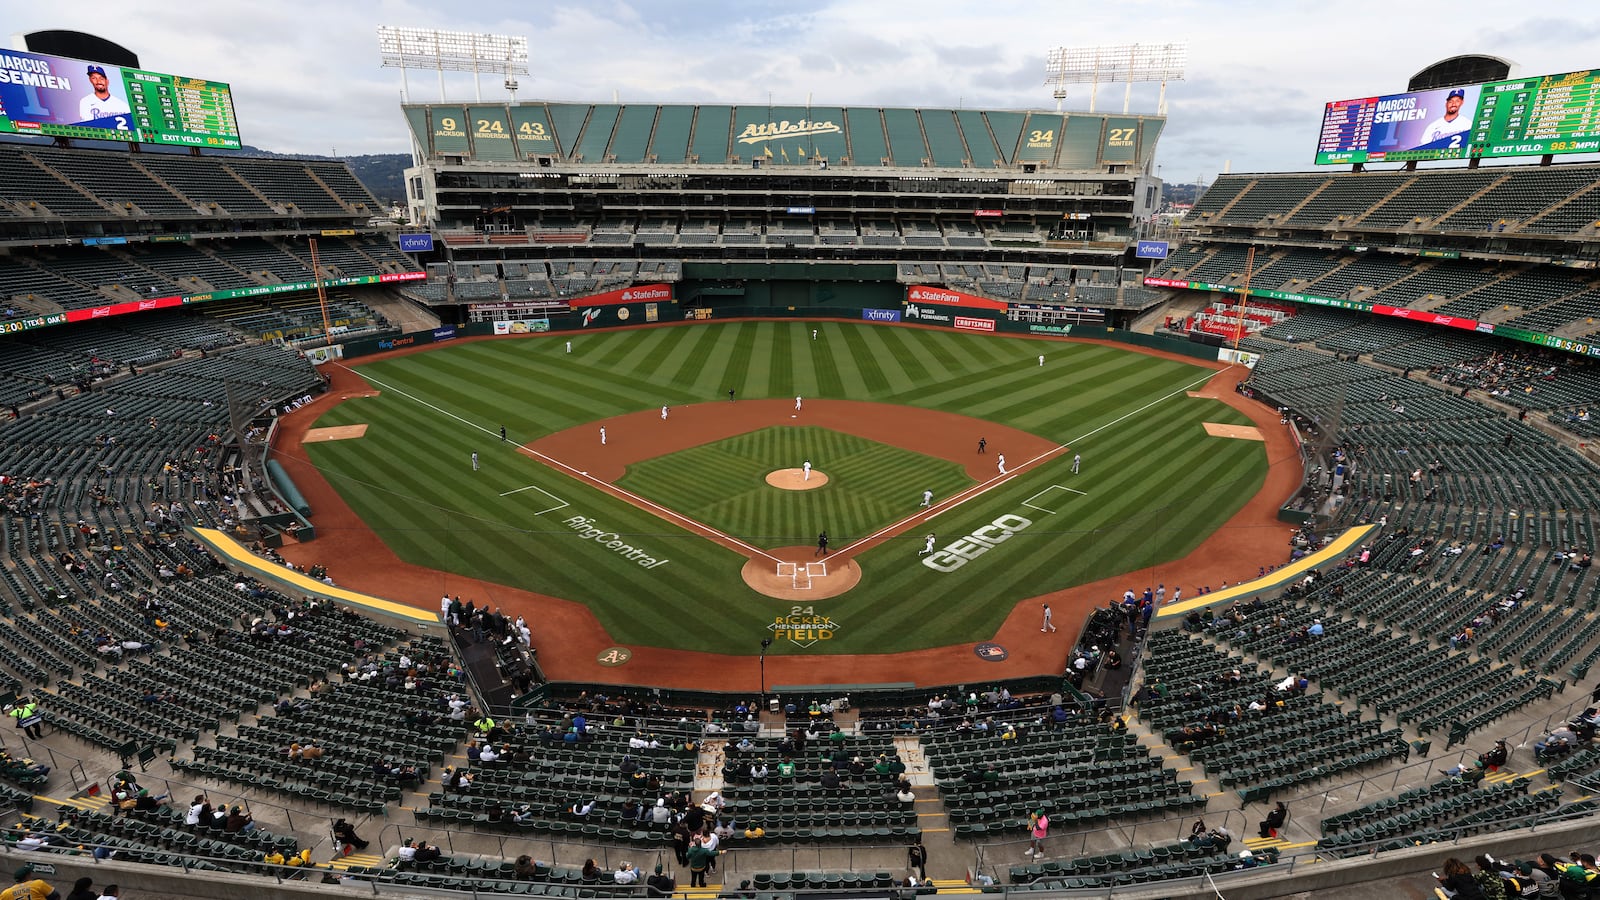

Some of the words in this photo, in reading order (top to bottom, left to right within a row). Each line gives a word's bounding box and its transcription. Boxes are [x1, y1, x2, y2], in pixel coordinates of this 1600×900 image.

[0, 69, 71, 90] SEMIEN
[1377, 98, 1416, 112] MARCUS
[1374, 108, 1427, 123] SEMIEN
[115, 116, 128, 130] 2
[442, 118, 456, 130] 9
[477, 120, 503, 133] 24
[520, 122, 545, 135] 43
[736, 119, 840, 144] Athletics
[1029, 130, 1053, 142] 34
[1109, 128, 1135, 141] 27
[1448, 135, 1462, 148] 2
[405, 239, 428, 247] xfinity
[1141, 246, 1164, 254] xfinity
[868, 310, 895, 320] xfinity
[956, 319, 992, 328] CRAFTSMAN
[378, 336, 414, 349] RingCentral
[562, 516, 669, 569] RingCentral
[922, 514, 1032, 572] GEICO
[791, 606, 814, 616] 24
[774, 630, 833, 640] FIELD
[600, 650, 627, 663] A's
